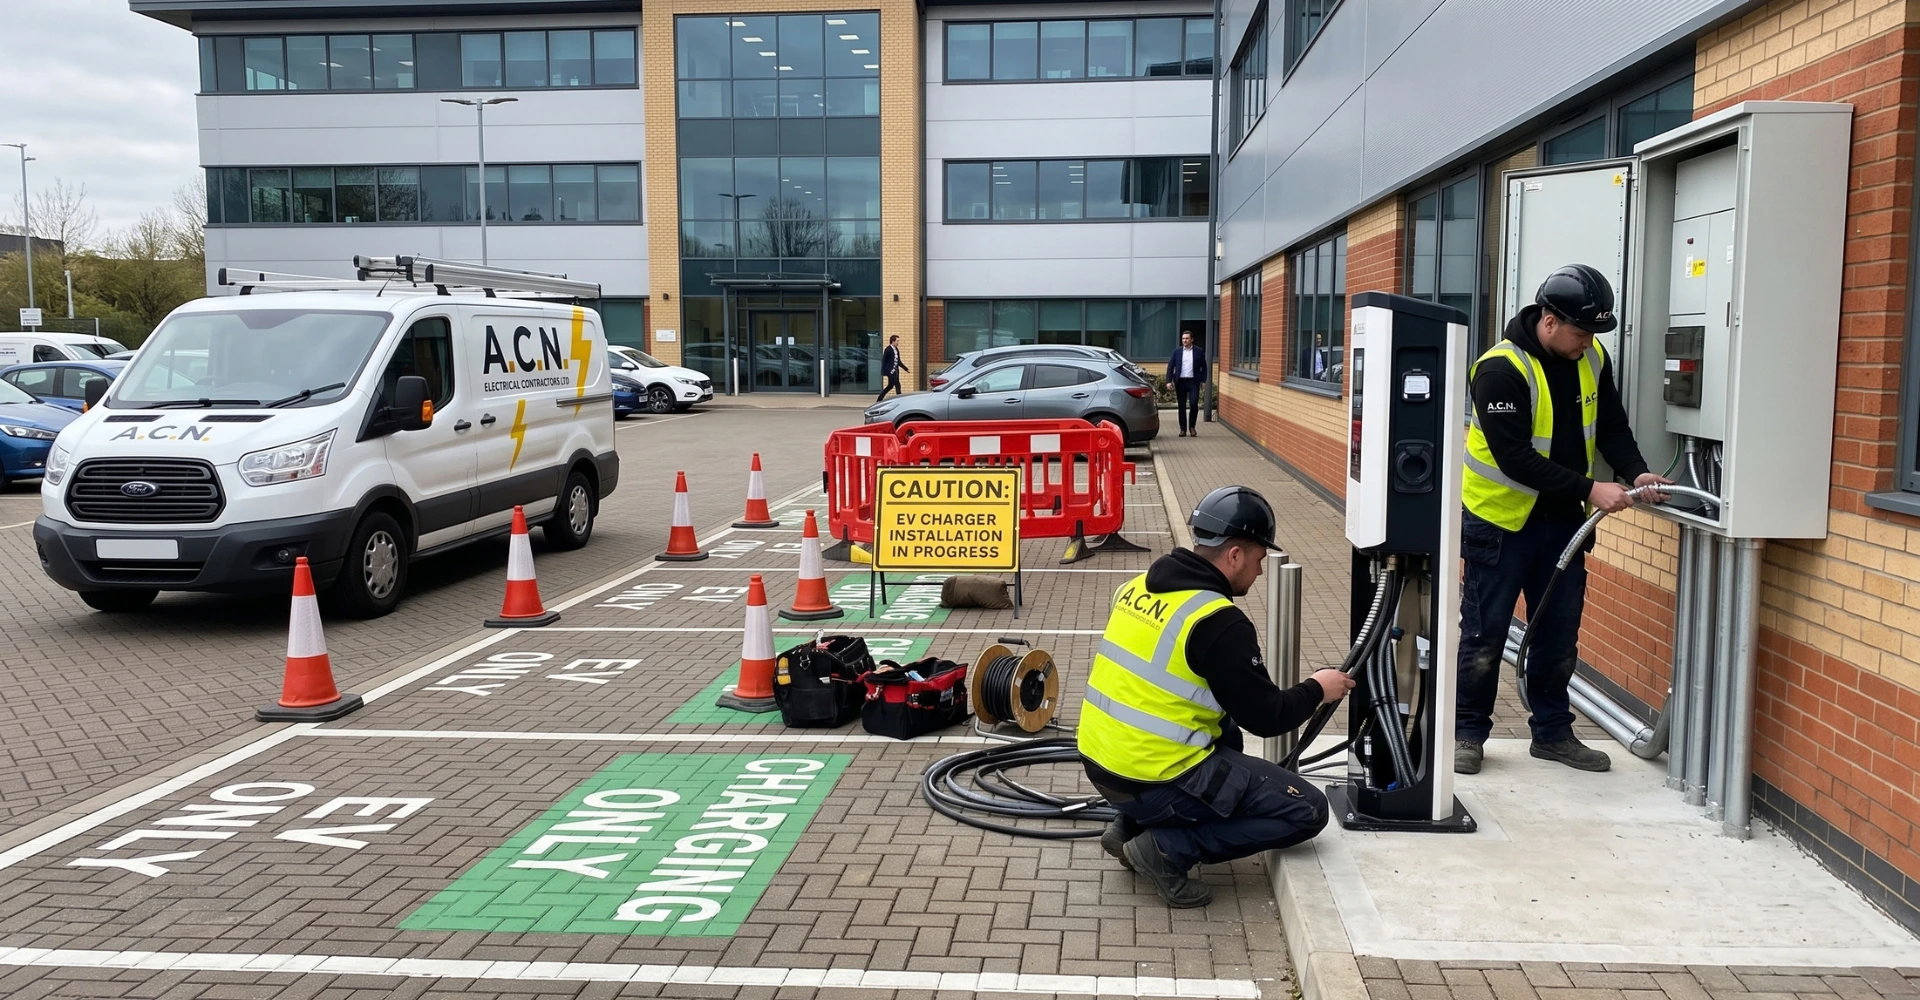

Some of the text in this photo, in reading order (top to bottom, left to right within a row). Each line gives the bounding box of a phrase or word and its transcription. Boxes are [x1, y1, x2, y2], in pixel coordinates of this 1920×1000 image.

[483, 325, 569, 374] A.C.N.
[484, 376, 569, 392] ELECTRICAL CONTRACTORS LTD
[1487, 401, 1517, 410] A.C.N.
[109, 425, 213, 442] A.C.N.
[126, 484, 148, 494] Ford
[889, 480, 1010, 499] CAUTION:
[896, 513, 997, 526] EV CHARGER
[889, 529, 1003, 541] INSTALLATION
[892, 545, 999, 558] IN PROGRESS
[593, 583, 684, 610] ONLY
[680, 586, 749, 603] EV
[1118, 586, 1169, 623] A.C.N.
[420, 652, 554, 696] ONLY
[545, 658, 644, 684] EV
[66, 782, 316, 878] ONLY
[273, 797, 436, 850] EV
[507, 788, 681, 879] ONLY
[612, 758, 825, 923] CHARGING
